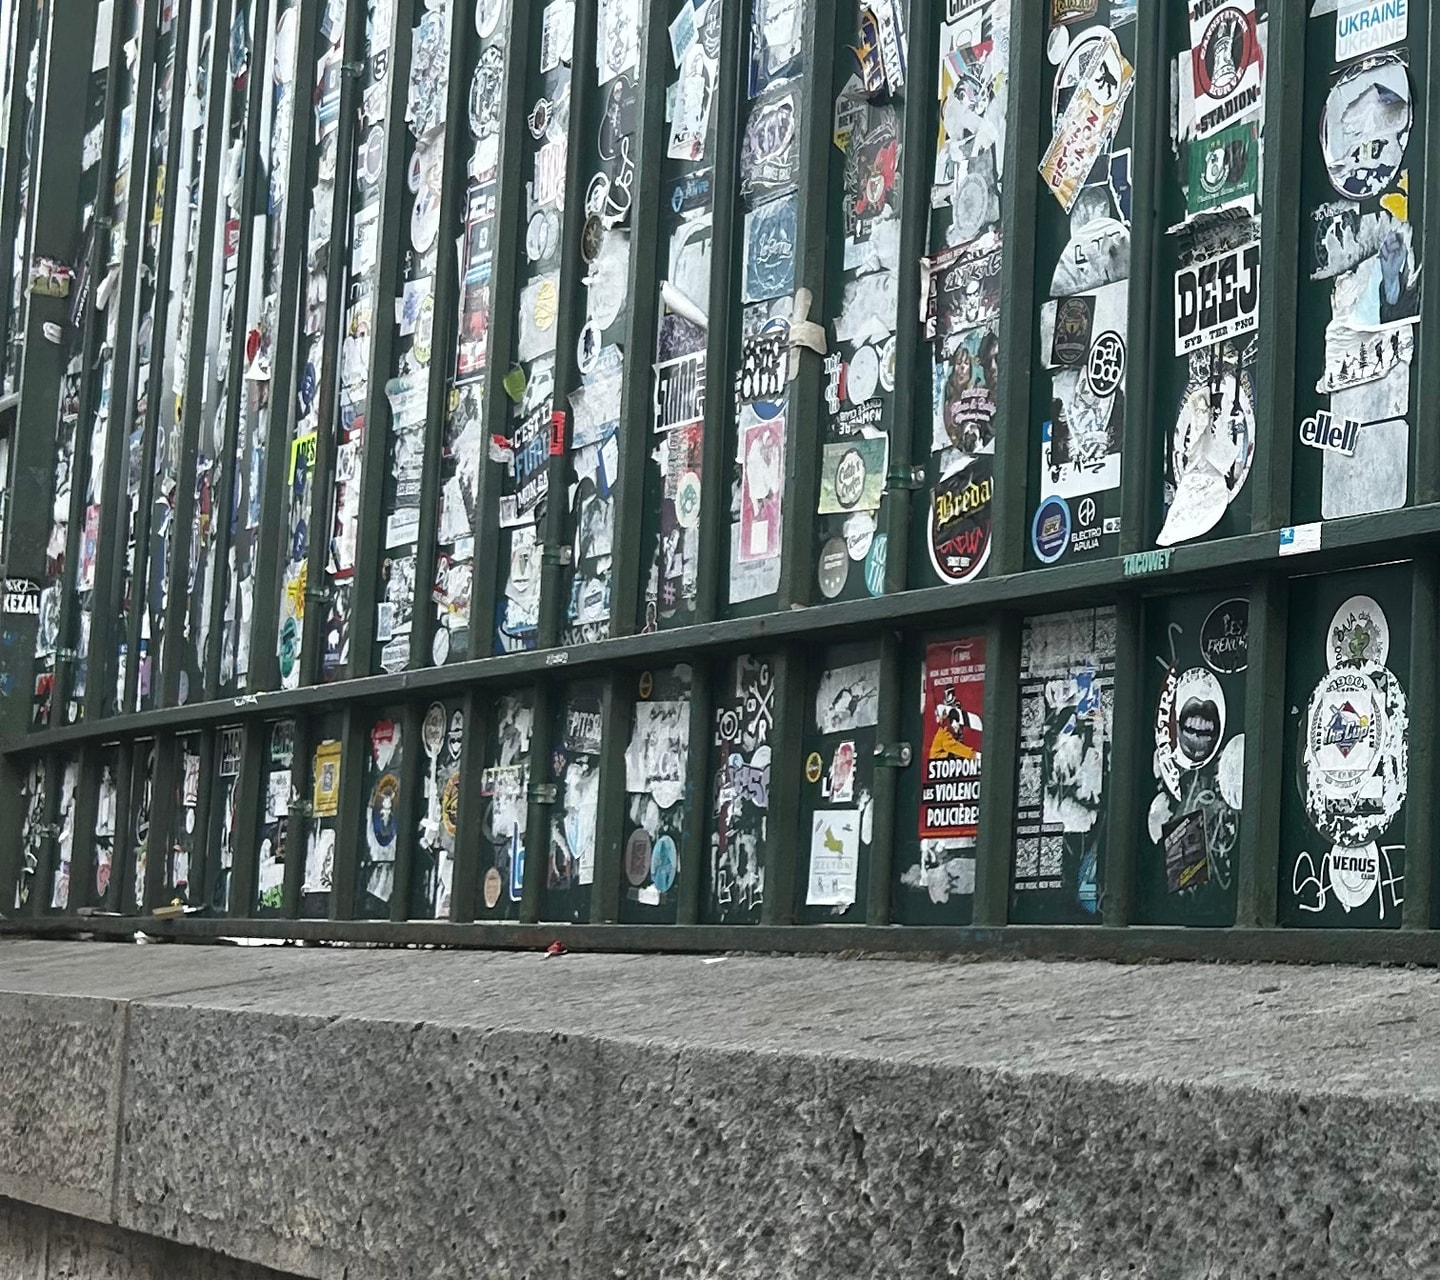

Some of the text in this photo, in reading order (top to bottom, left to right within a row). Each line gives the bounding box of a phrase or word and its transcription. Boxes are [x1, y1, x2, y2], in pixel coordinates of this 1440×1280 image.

[1199, 83, 1258, 135] STADION
[1095, 340, 1122, 362] Bar
[1091, 357, 1121, 384] Bob
[1301, 417, 1360, 452] ellell
[936, 479, 992, 527] Breda
[1070, 528, 1102, 544] ELECTRO
[1073, 539, 1101, 553] APULIA
[922, 788, 935, 802] LES
[1332, 855, 1377, 874] VENUS
